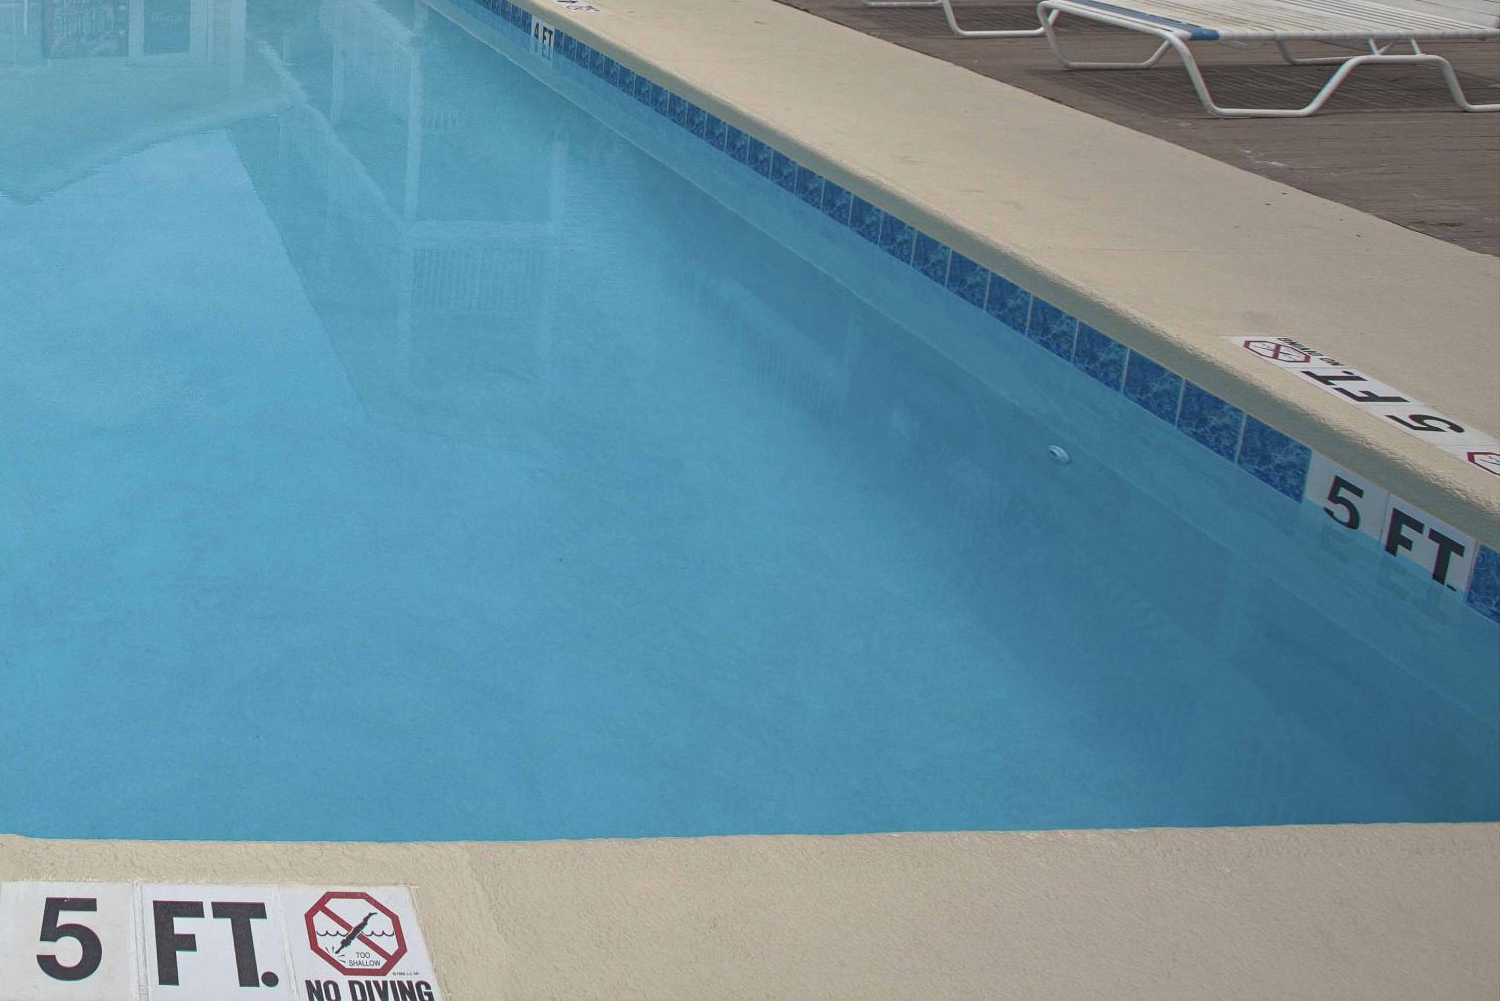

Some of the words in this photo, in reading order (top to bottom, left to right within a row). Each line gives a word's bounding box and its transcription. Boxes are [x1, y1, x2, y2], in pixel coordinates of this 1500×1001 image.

[534, 22, 539, 39] 4
[1384, 413, 1466, 434] 5
[1323, 474, 1364, 530] 5
[36, 897, 103, 982] 5
[153, 900, 280, 988] FT.
[304, 979, 342, 1001] NO
[347, 979, 436, 1001] DIVING
